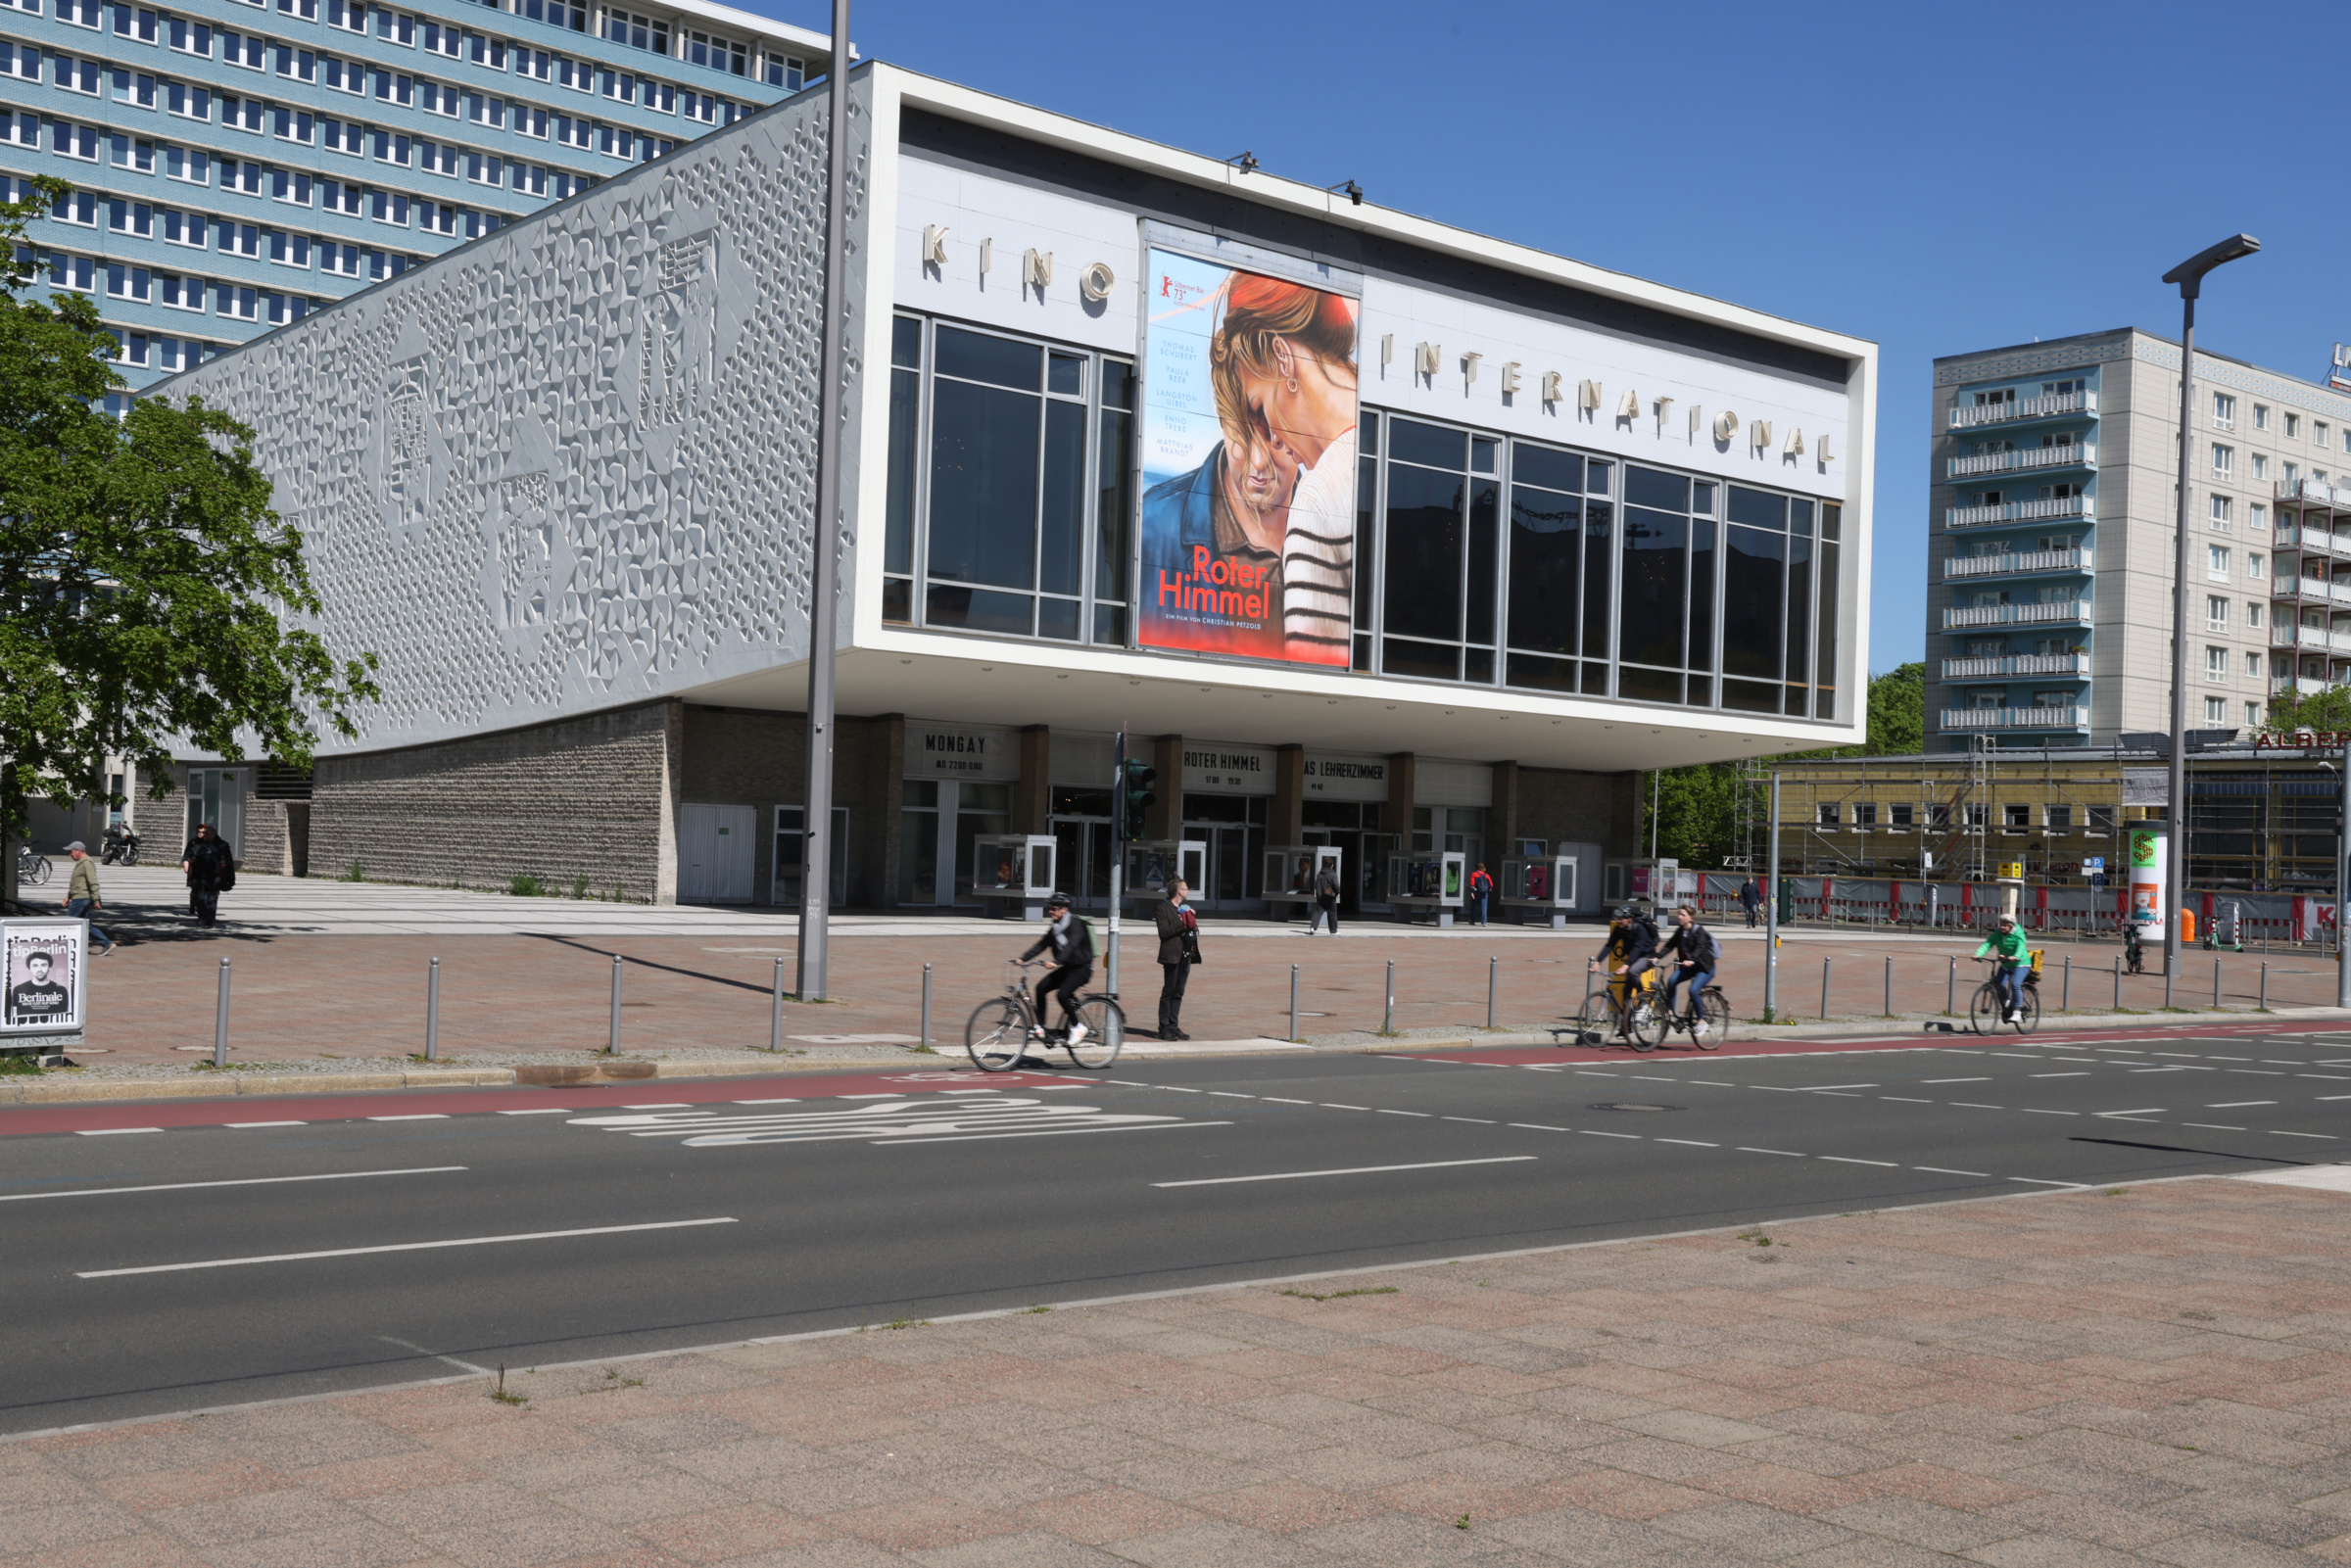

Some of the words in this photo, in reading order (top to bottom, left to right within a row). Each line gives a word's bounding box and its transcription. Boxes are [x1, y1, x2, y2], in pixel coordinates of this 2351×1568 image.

[924, 223, 1115, 302] KINO
[1381, 333, 1836, 463] INTERNATIONAL
[1163, 340, 1194, 354] THOMAS
[1160, 348, 1197, 361] SCHUBERT
[1166, 365, 1189, 377] PAULA
[1169, 374, 1186, 384] BEER
[1156, 388, 1197, 403] LANGSTON
[1167, 399, 1186, 408] UIBEL
[1165, 414, 1186, 425] ENNO
[1165, 422, 1186, 433] TREBS
[1157, 438, 1193, 451] MATTHIAS
[1160, 446, 1189, 457] BRANDT
[1193, 545, 1268, 590] Roter
[1158, 569, 1270, 619] Himmel
[1202, 617, 1234, 627] CHRISTIAN
[1236, 621, 1262, 630] PETZOLD
[926, 734, 985, 754] MONGAY
[1183, 751, 1217, 769] ROTER
[1221, 753, 1261, 772] HIMMEL
[1320, 761, 1383, 780] LEHRERZIMMER
[18, 991, 64, 1004] Berlinale
